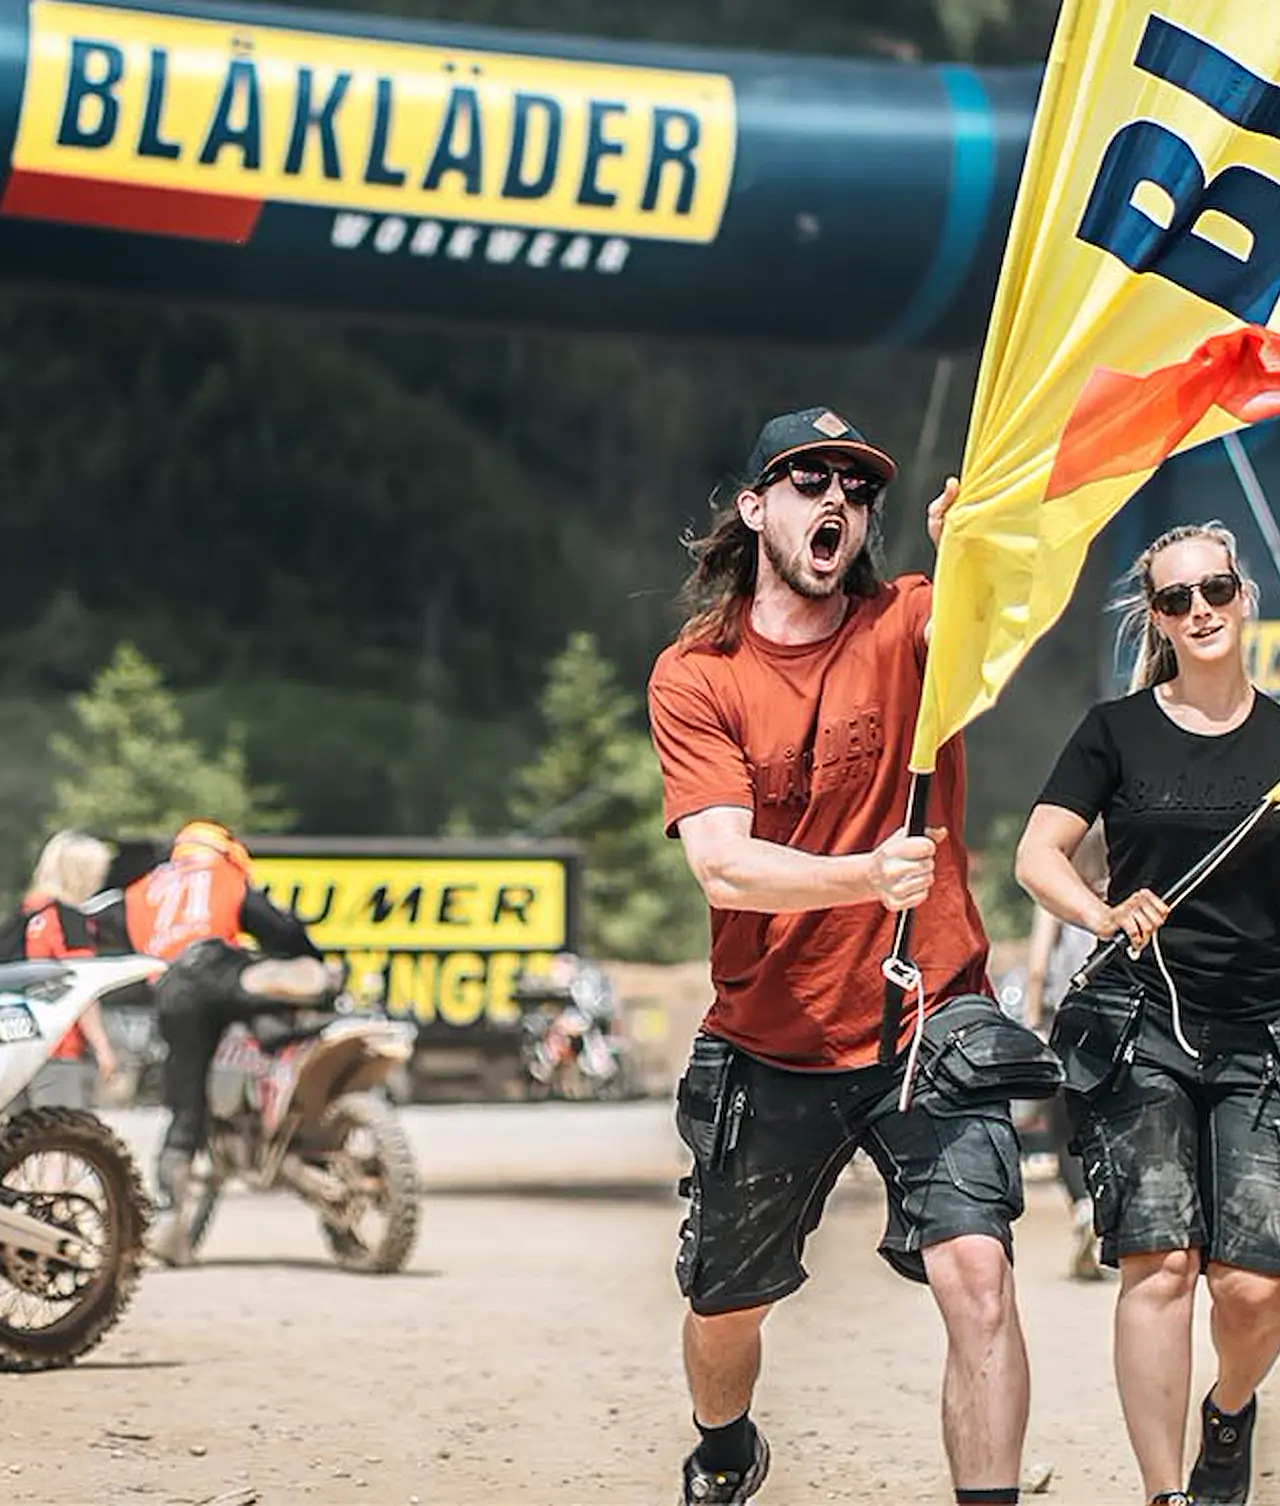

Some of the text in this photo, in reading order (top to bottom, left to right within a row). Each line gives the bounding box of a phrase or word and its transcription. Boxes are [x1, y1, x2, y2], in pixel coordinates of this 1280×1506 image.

[55, 36, 702, 217] BLÅKLÄDER
[330, 211, 631, 275] WORKWEAR
[263, 884, 540, 926] UMER
